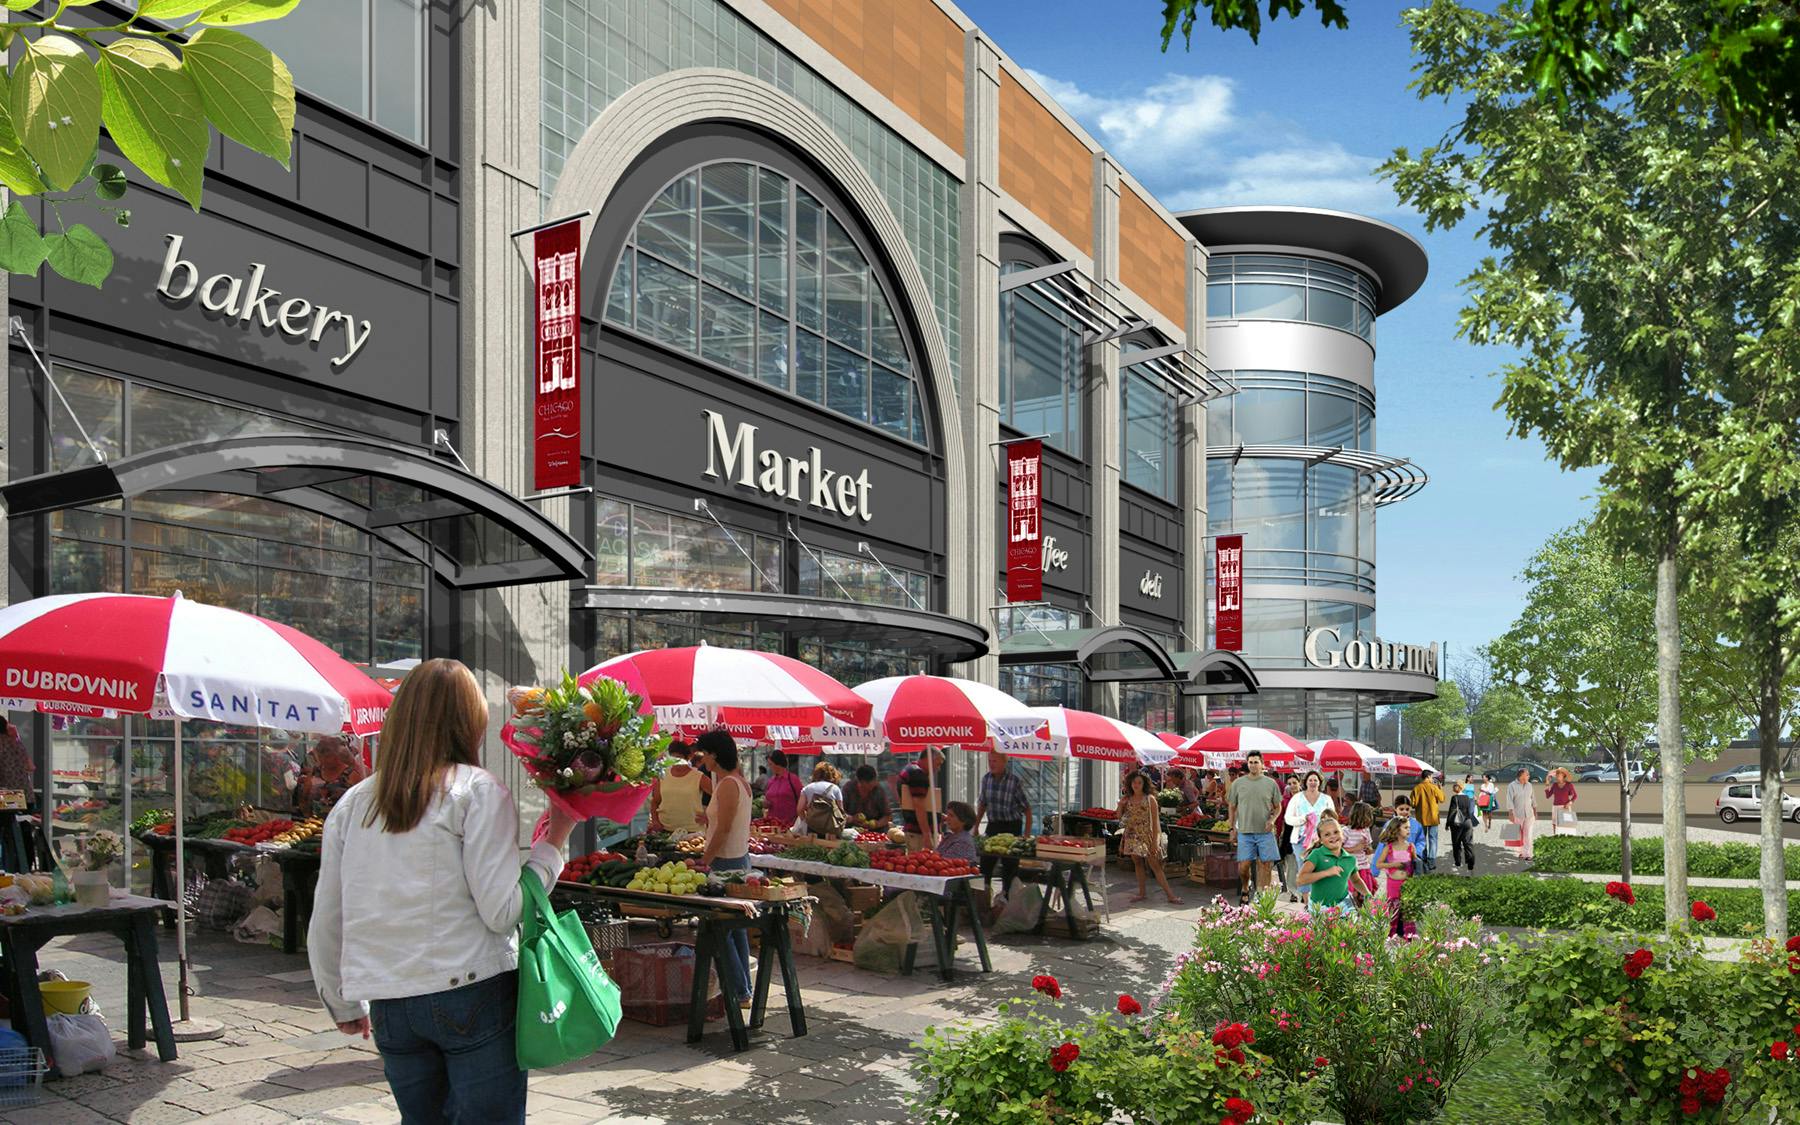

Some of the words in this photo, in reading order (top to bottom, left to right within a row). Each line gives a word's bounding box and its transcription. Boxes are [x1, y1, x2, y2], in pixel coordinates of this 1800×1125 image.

[157, 233, 371, 366] bakery
[538, 400, 574, 416] CHICAGO
[703, 408, 872, 522] Market
[1041, 535, 1068, 572] ffee
[1140, 570, 1162, 599] deli
[1305, 626, 1439, 676] Gourmet
[6, 668, 138, 700] DUBROVNIK
[190, 690, 319, 722] SANITAT
[900, 725, 974, 738] DUBROVNIK
[1004, 741, 1059, 752] SANITAT
